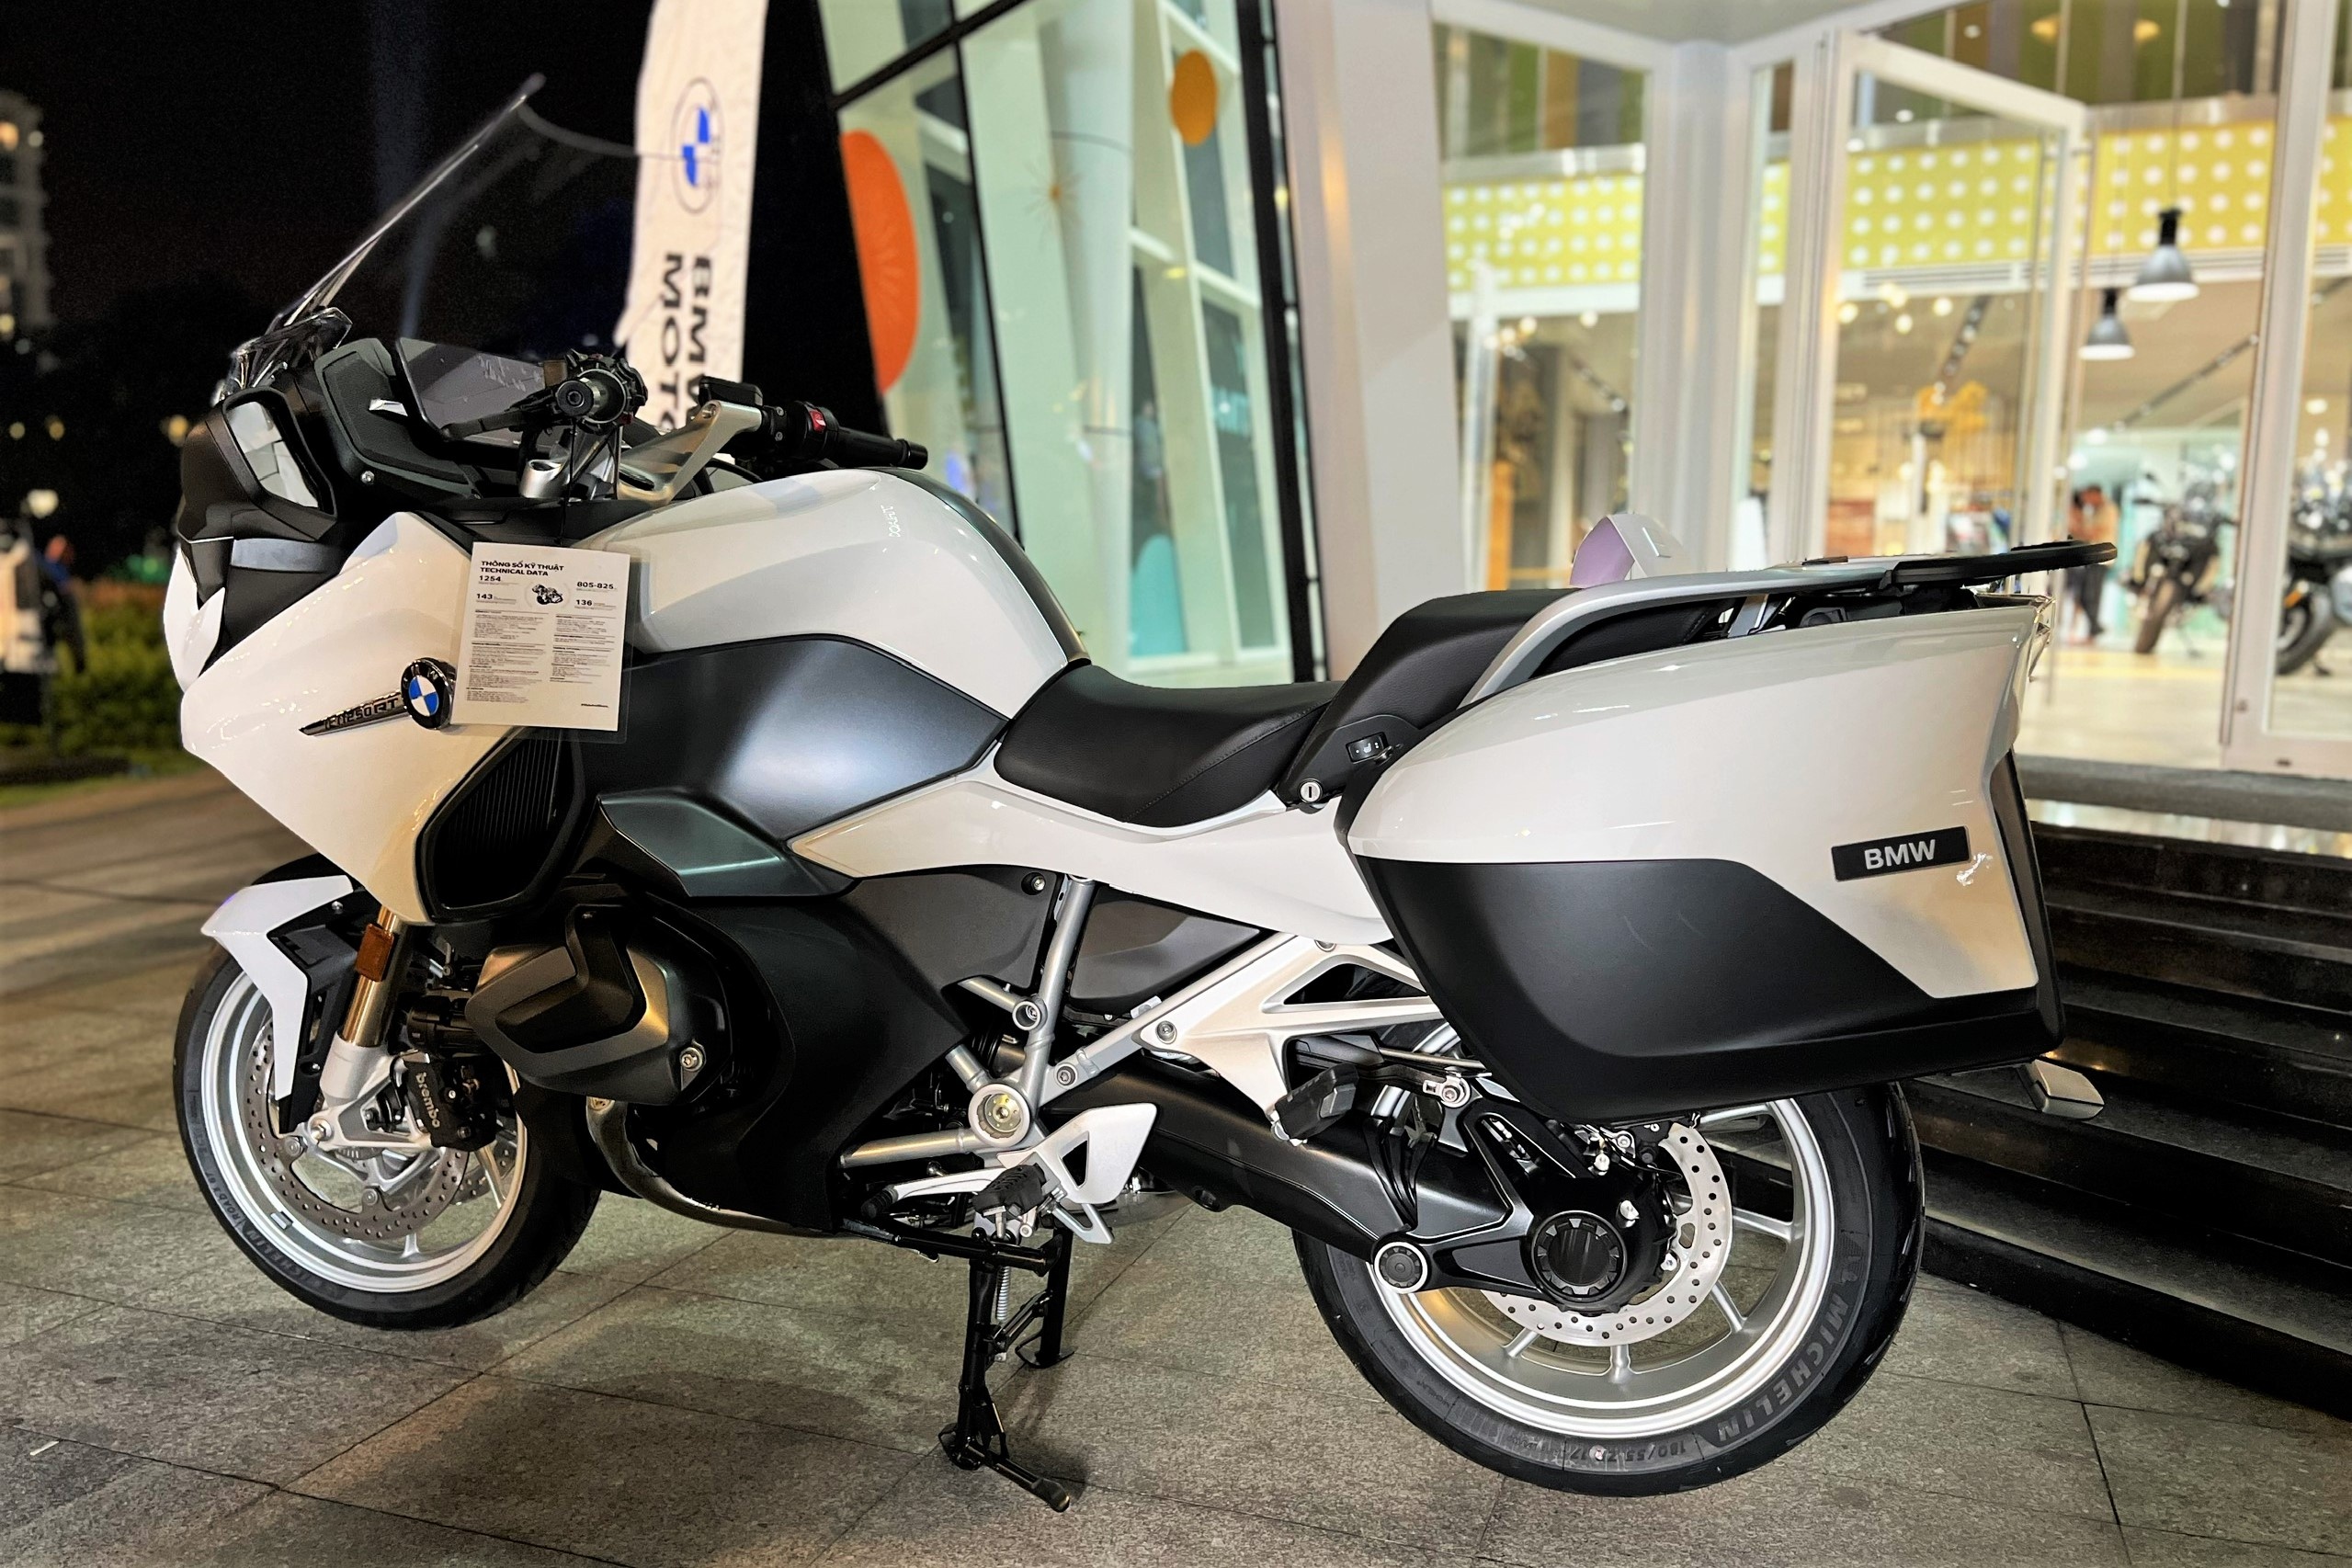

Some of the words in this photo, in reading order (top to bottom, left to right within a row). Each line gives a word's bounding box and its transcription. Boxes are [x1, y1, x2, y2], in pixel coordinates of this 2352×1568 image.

[480, 567, 525, 575] TECHNICAL
[481, 560, 511, 568] THÔNG
[576, 581, 614, 589] 805-825
[1864, 839, 1936, 869] BMW
[415, 1072, 441, 1129] brembo
[1717, 1291, 1849, 1443] MICHELIN
